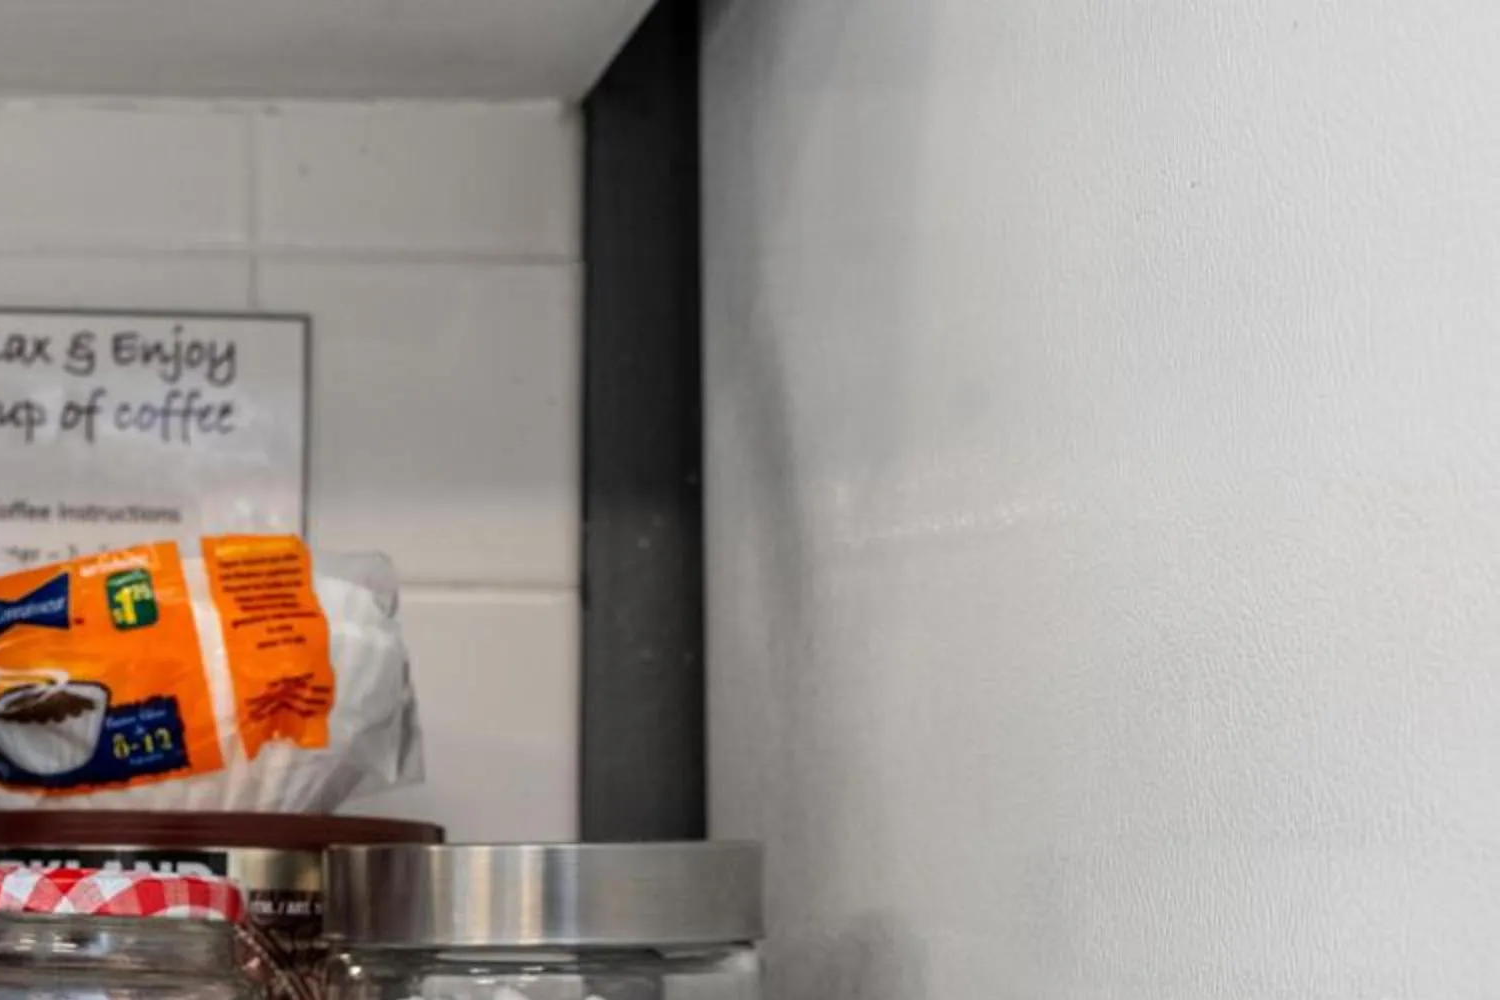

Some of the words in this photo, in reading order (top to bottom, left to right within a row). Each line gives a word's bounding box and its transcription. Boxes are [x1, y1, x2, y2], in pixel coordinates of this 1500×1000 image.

[111, 325, 238, 386] Enjoy
[60, 389, 107, 442] of
[112, 389, 236, 442] coffee
